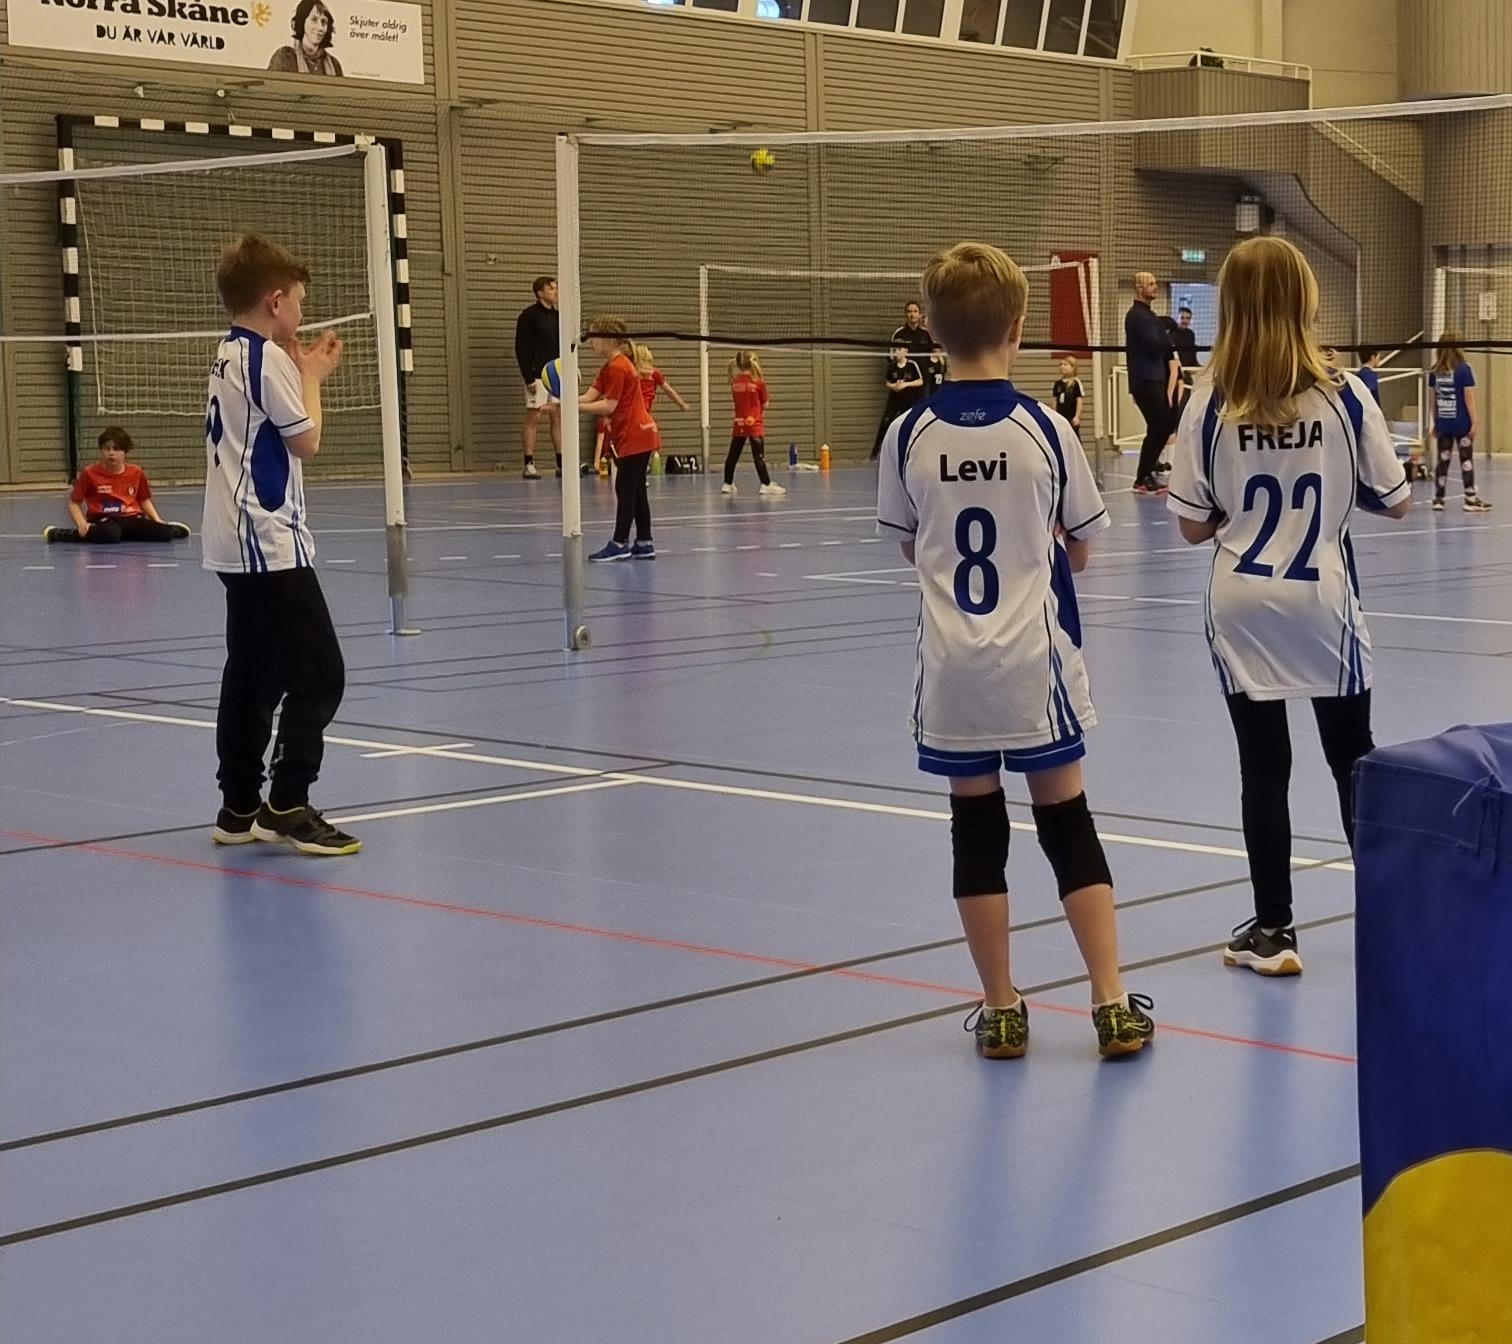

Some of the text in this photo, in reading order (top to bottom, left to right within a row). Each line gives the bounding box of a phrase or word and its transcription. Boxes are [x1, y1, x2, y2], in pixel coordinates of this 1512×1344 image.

[96, 25, 117, 41] DU
[123, 24, 142, 42] ÄR
[182, 30, 225, 51] VÄRLD
[350, 16, 407, 33] Skjuter aldrig
[350, 29, 369, 39] över
[1238, 420, 1323, 452] FREJA
[940, 452, 1008, 482] Levi
[1233, 472, 1322, 582] 22
[953, 507, 1000, 616] 8
